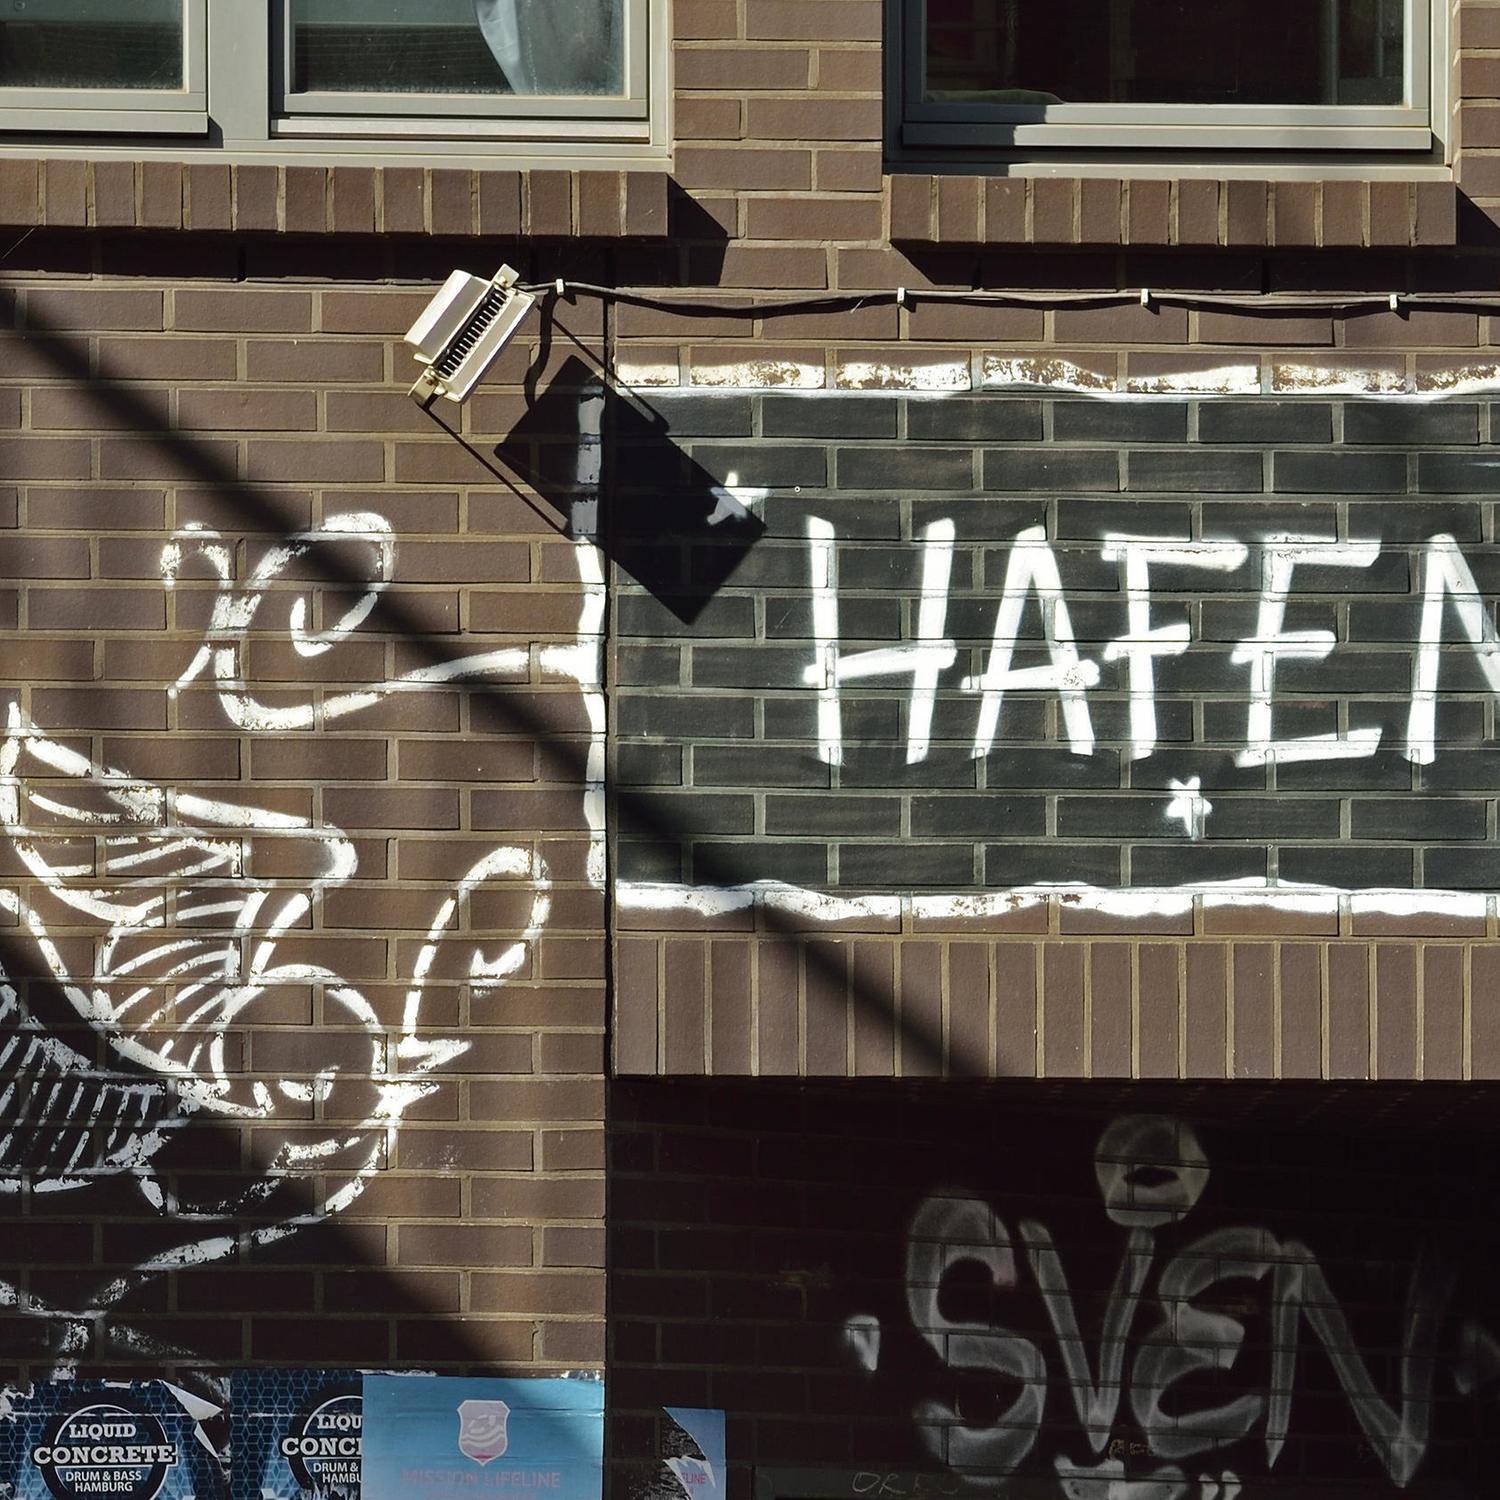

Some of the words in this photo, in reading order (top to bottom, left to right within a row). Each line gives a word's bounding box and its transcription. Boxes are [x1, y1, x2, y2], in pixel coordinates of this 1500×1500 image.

[69, 1423, 137, 1441] LIQUID
[281, 1437, 362, 1456] CONC
[34, 1445, 174, 1465] CONCRETE
[313, 1462, 347, 1473] DRUM
[350, 1462, 358, 1473] &
[66, 1471, 100, 1482] DRUM
[102, 1471, 111, 1481] &
[113, 1471, 142, 1481] BASS
[75, 1481, 133, 1493] HAMBURG
